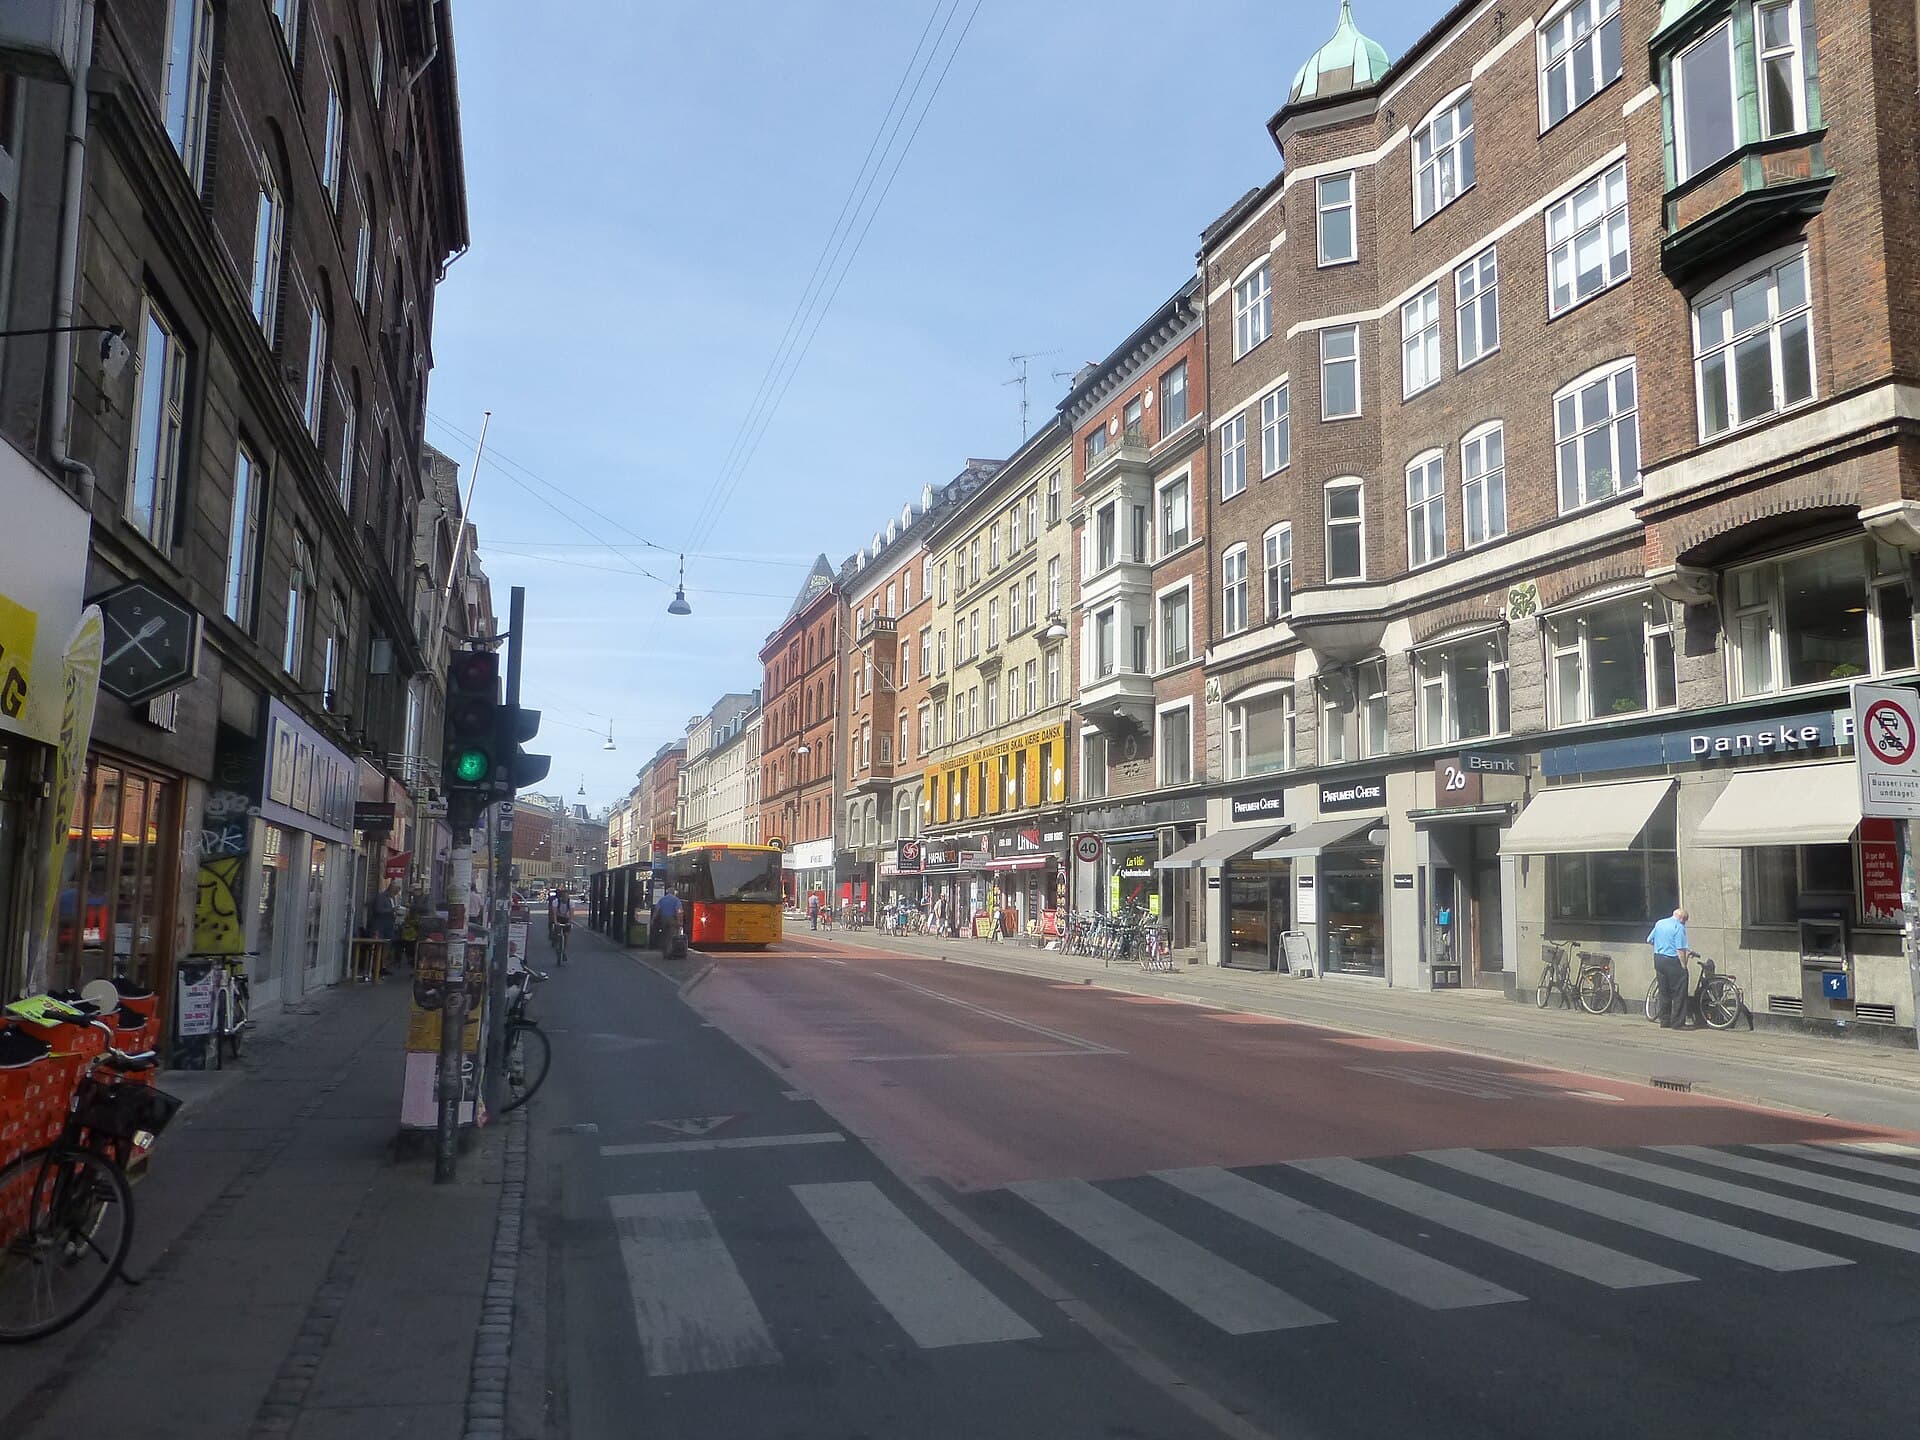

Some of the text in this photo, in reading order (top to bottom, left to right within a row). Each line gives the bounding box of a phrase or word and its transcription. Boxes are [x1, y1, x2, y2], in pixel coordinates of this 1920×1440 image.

[1010, 736, 1024, 751] SKAL
[1041, 725, 1062, 742] DANSK
[1689, 724, 1820, 754] Danske
[1470, 756, 1516, 771] Bank
[1445, 766, 1466, 791] 26
[1079, 842, 1097, 854] 40
